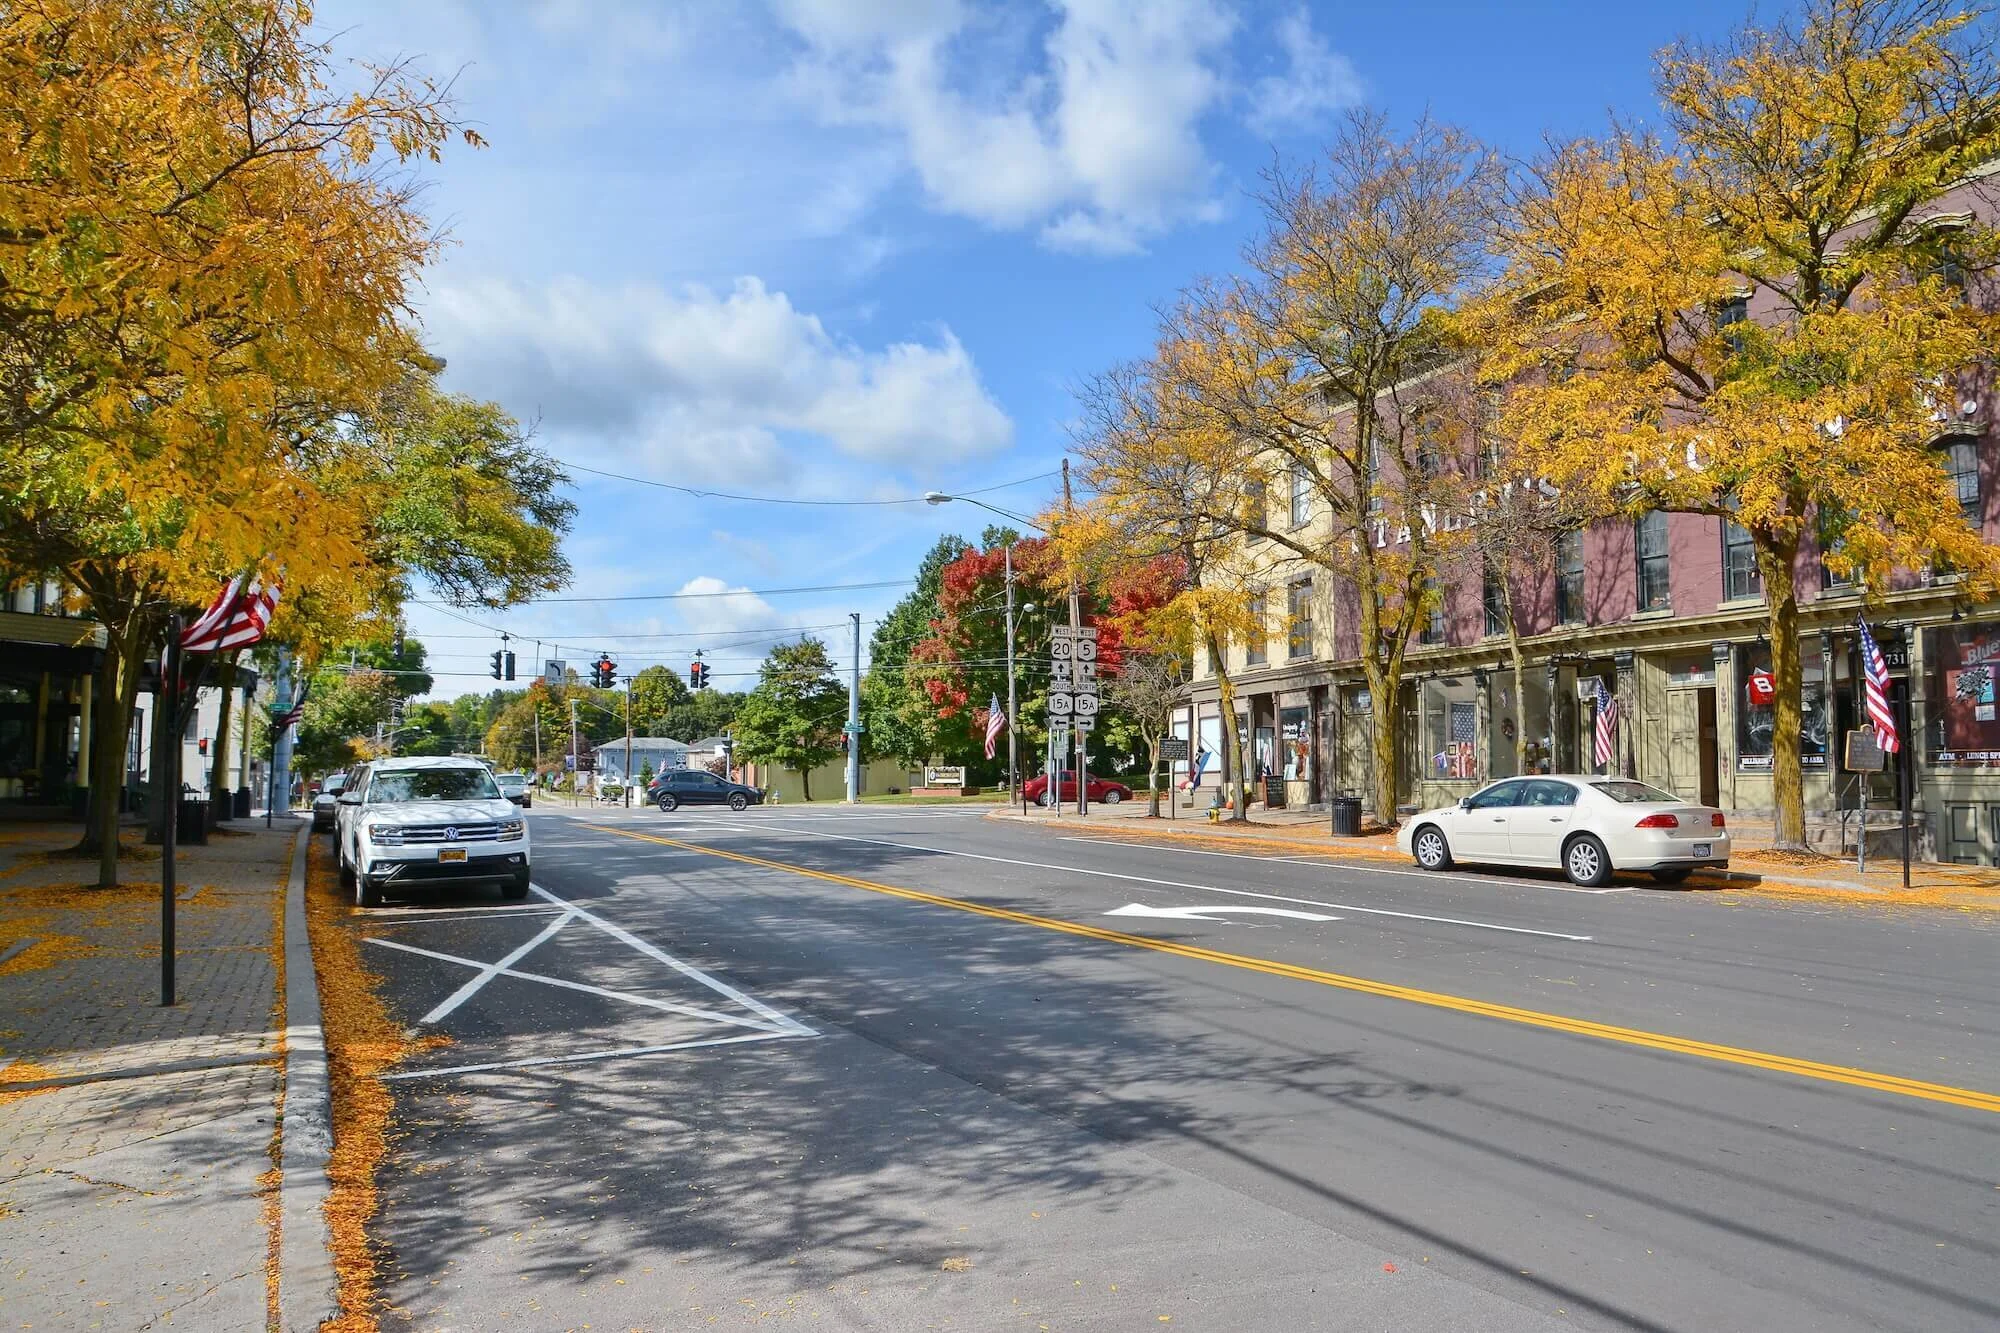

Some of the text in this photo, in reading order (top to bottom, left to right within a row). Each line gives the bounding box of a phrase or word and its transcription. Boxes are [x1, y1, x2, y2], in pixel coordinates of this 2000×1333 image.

[1080, 629, 1094, 637] WEST
[1053, 643, 1070, 655] 20
[1083, 644, 1091, 656] 5
[1885, 653, 1905, 665] 731
[1052, 682, 1071, 690] SOUTH
[1077, 683, 1096, 691] NORTH
[1753, 677, 1774, 693] 8
[1052, 698, 1070, 709] 15A
[1078, 699, 1095, 710] 15A
